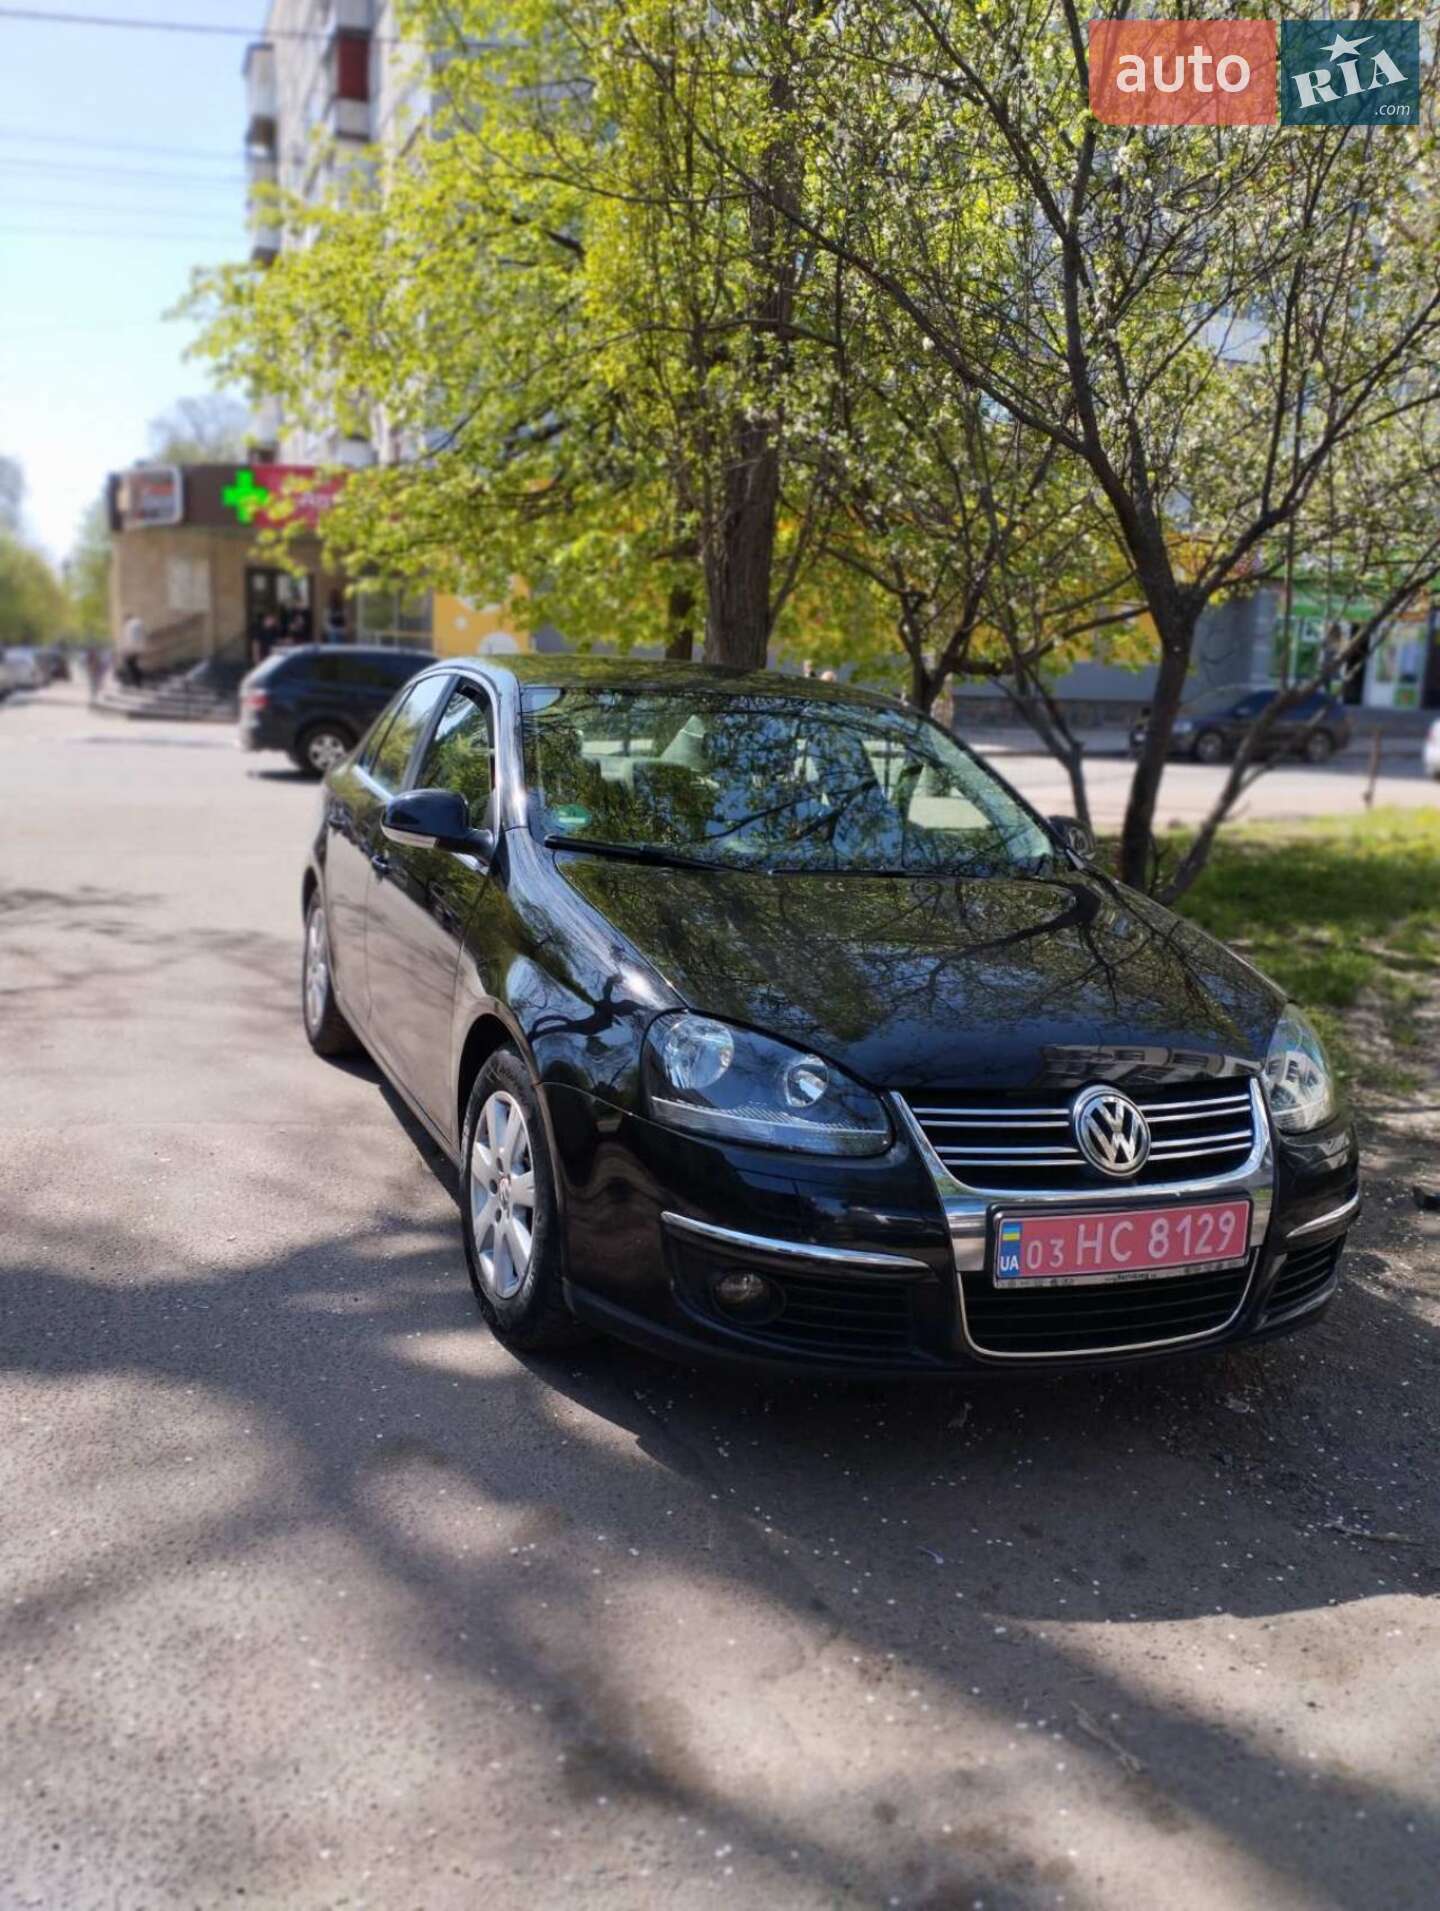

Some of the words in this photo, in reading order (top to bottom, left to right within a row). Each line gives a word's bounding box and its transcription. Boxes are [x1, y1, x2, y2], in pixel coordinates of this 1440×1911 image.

[1026, 1239, 1065, 1270] 03
[1076, 1221, 1134, 1265] HC
[1148, 1210, 1236, 1259] 8129
[1000, 1255, 1019, 1271] UA
